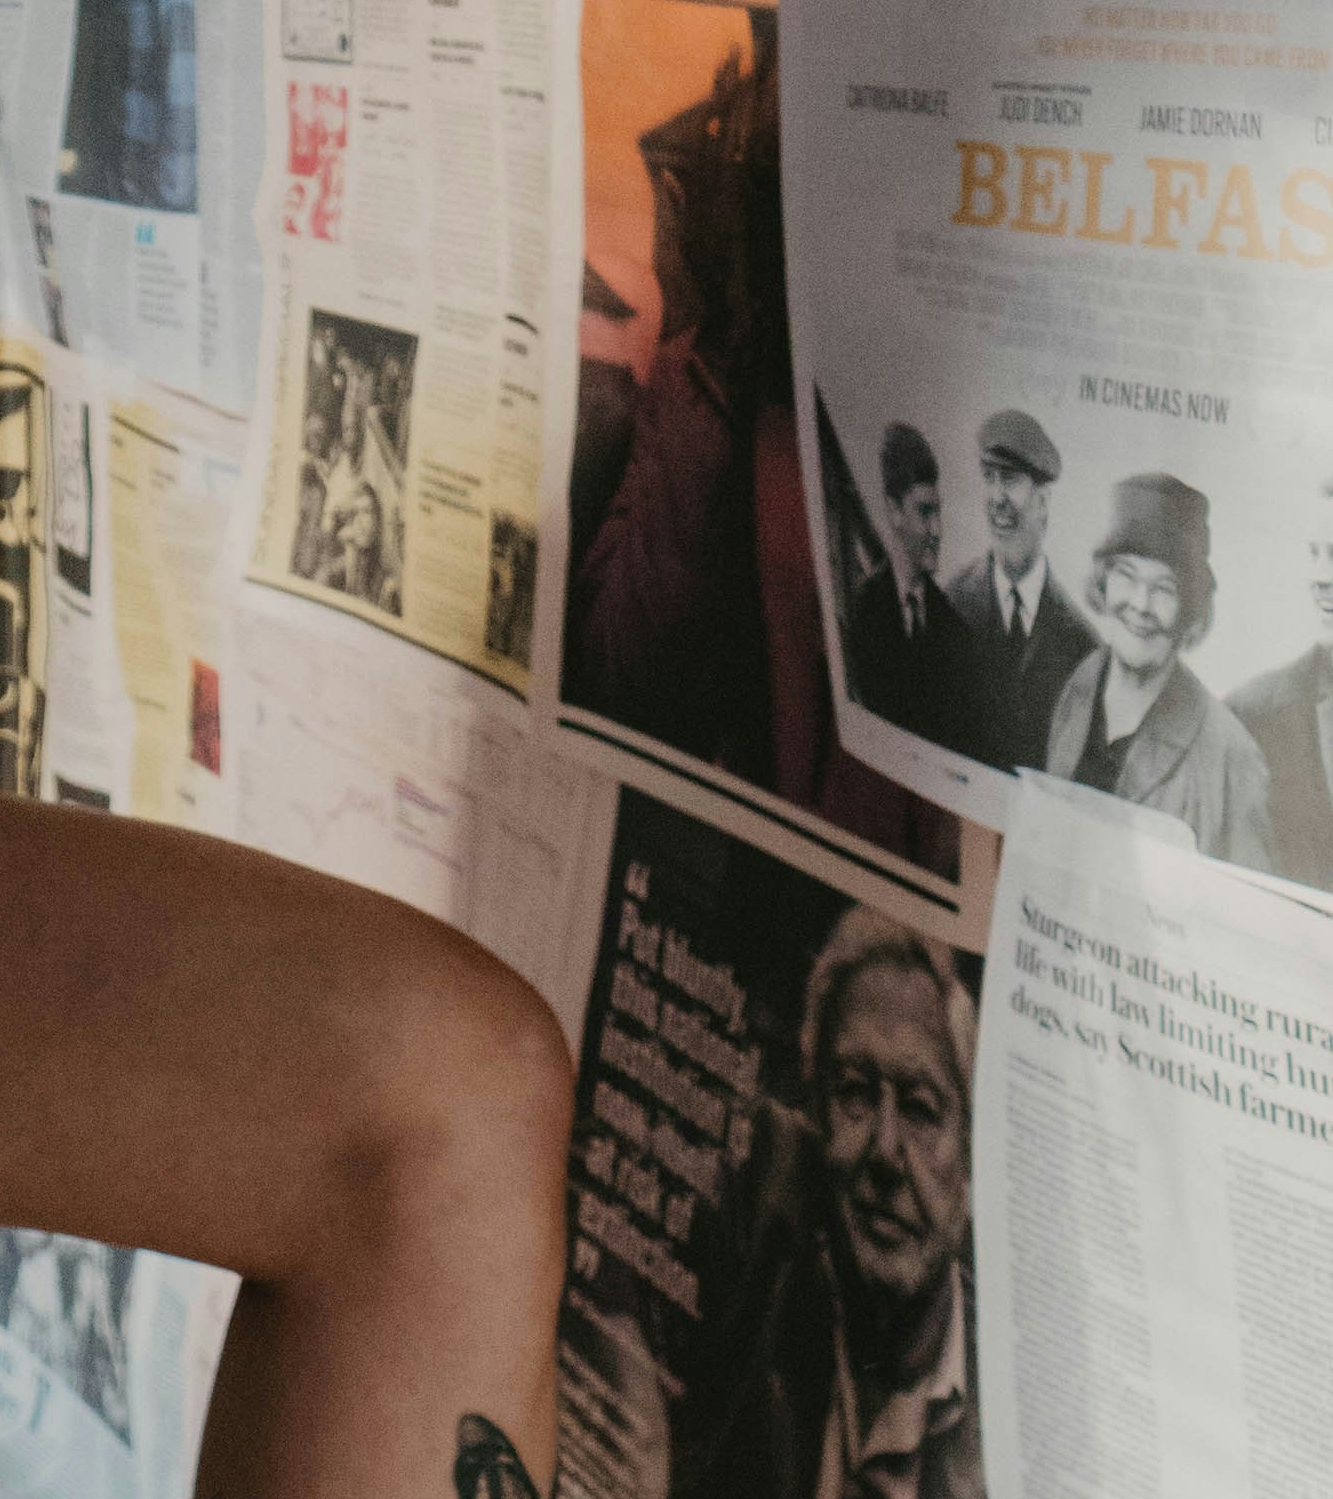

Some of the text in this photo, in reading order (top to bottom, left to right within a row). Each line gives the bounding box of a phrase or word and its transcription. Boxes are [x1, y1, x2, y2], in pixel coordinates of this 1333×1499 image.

[1032, 96, 1083, 127] DENCH
[1139, 104, 1263, 140] JAMIE DORNAN
[949, 138, 1333, 273] BELFAS
[1079, 374, 1230, 426] IN CINEMAS NOW
[1020, 894, 1122, 970] Sturgeon
[1126, 952, 1260, 1034] attacking
[1014, 937, 1049, 979] life
[1051, 962, 1105, 1008] with
[1109, 980, 1151, 1029] law
[1157, 1003, 1280, 1087] limiting
[1072, 1022, 1109, 1064] say
[1116, 1031, 1233, 1109] Scottish
